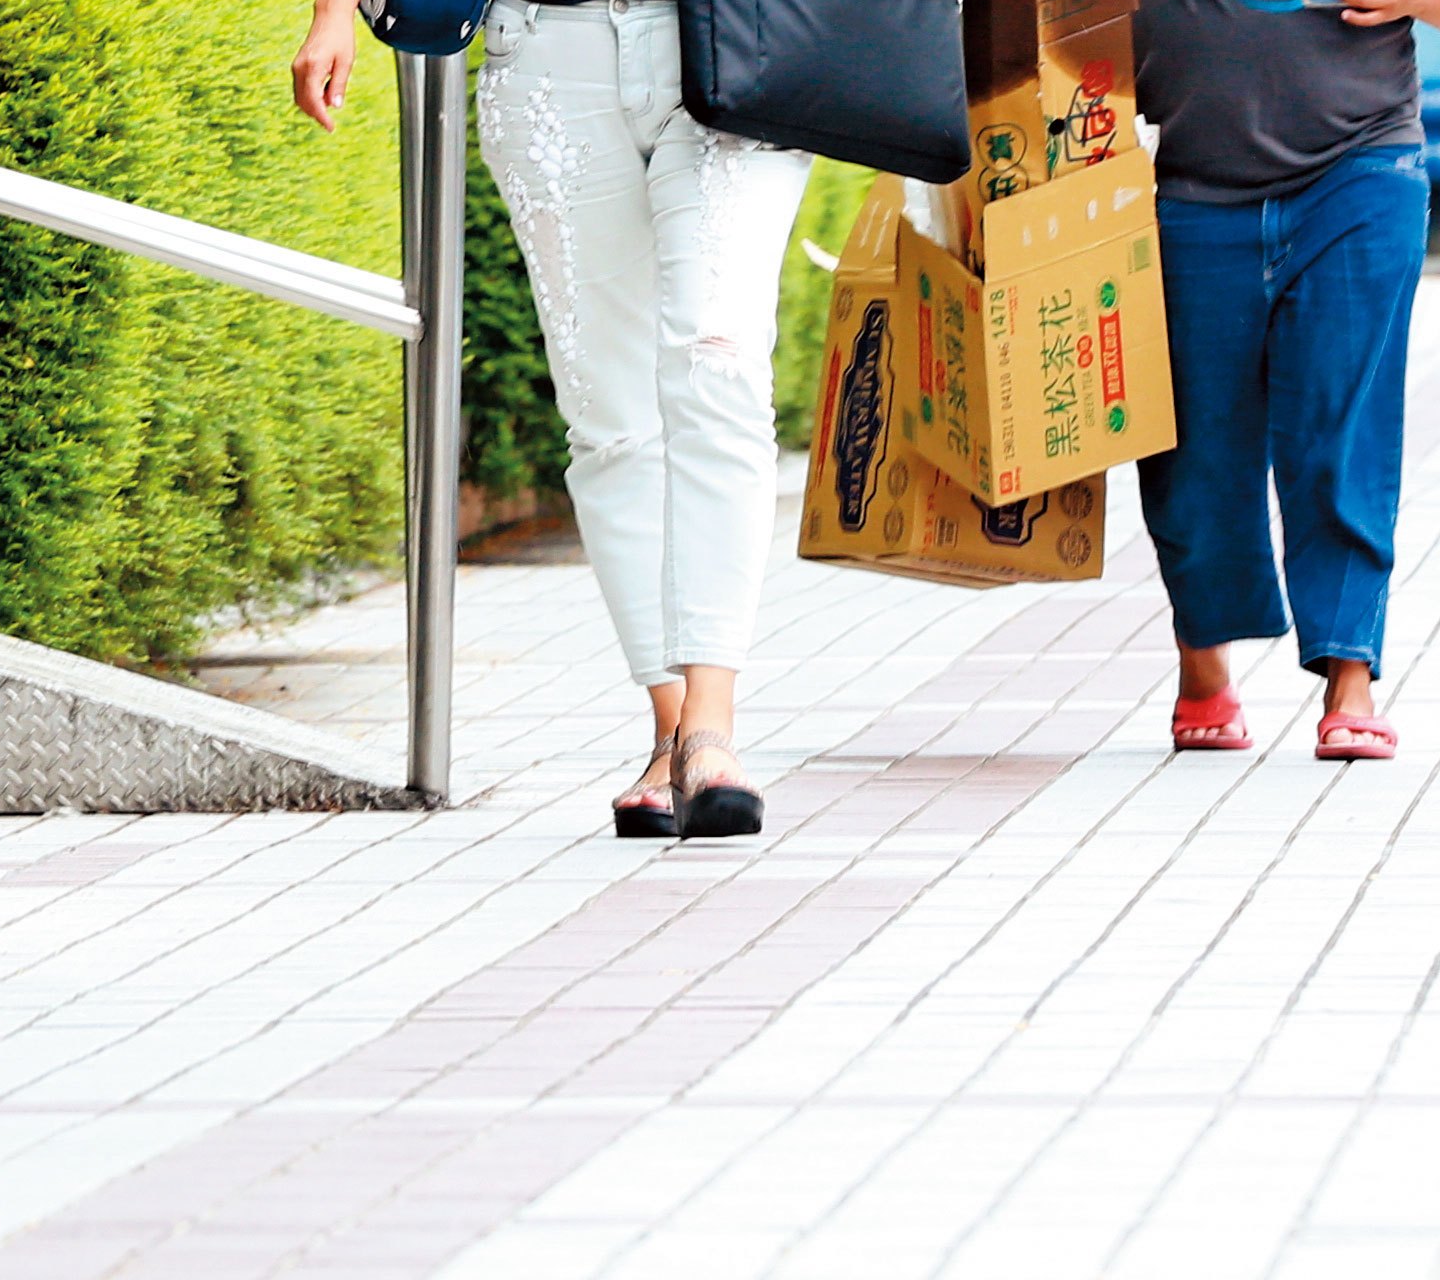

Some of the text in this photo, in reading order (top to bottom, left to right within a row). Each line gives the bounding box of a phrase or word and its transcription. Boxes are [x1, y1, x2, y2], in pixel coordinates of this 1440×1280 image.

[989, 288, 1006, 339] 1478
[1037, 288, 1081, 459] 黑松茶花
